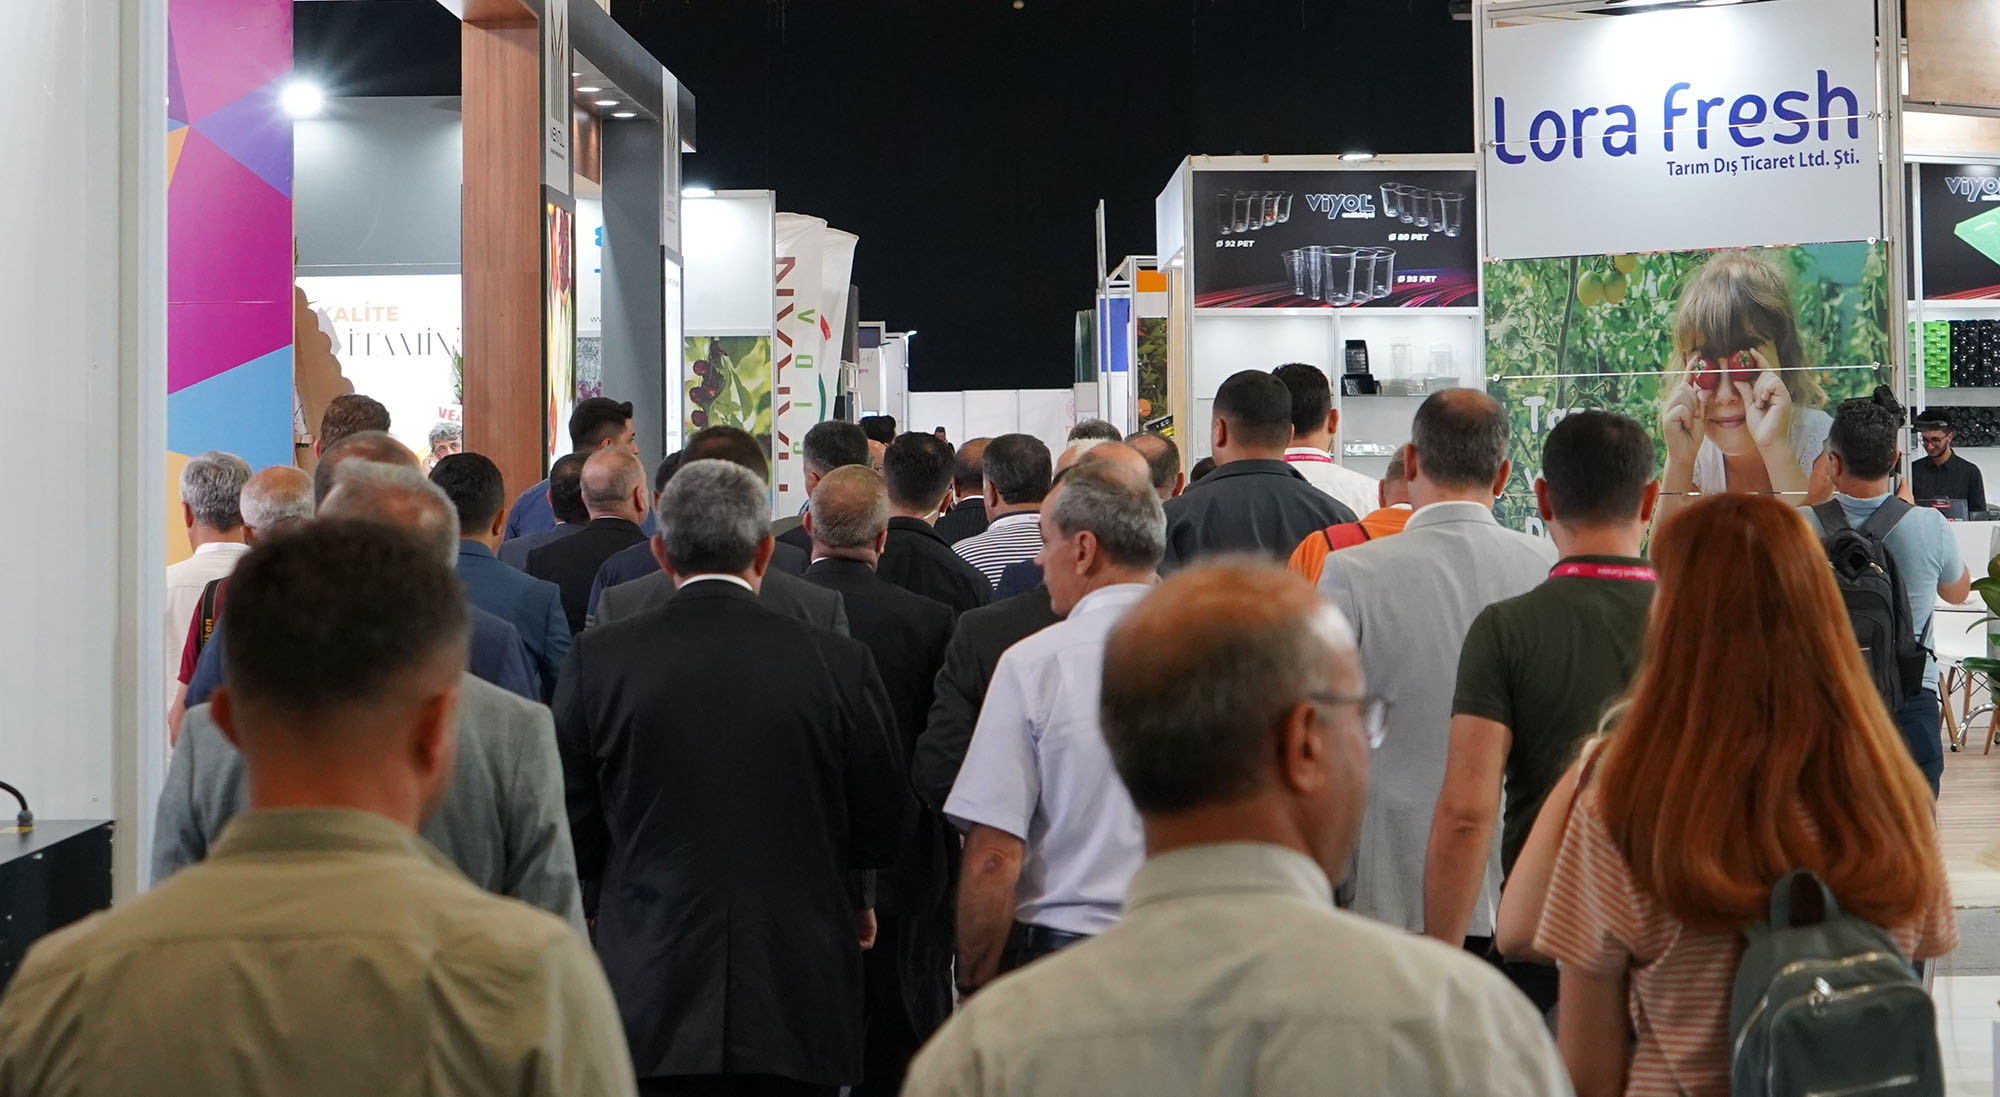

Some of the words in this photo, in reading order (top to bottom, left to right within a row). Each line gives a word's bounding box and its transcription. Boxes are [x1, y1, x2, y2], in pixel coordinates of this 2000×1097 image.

[1494, 96, 1637, 165] Lora
[1663, 69, 1859, 152] fresh
[1667, 161, 1709, 176] Tarım
[1714, 158, 1738, 176] Dış
[1741, 155, 1795, 172] Ticaret
[1799, 150, 1830, 168] Ltd.
[1834, 148, 1860, 170] Şti.
[1410, 233, 1429, 241] PET
[1419, 275, 1438, 283] PET
